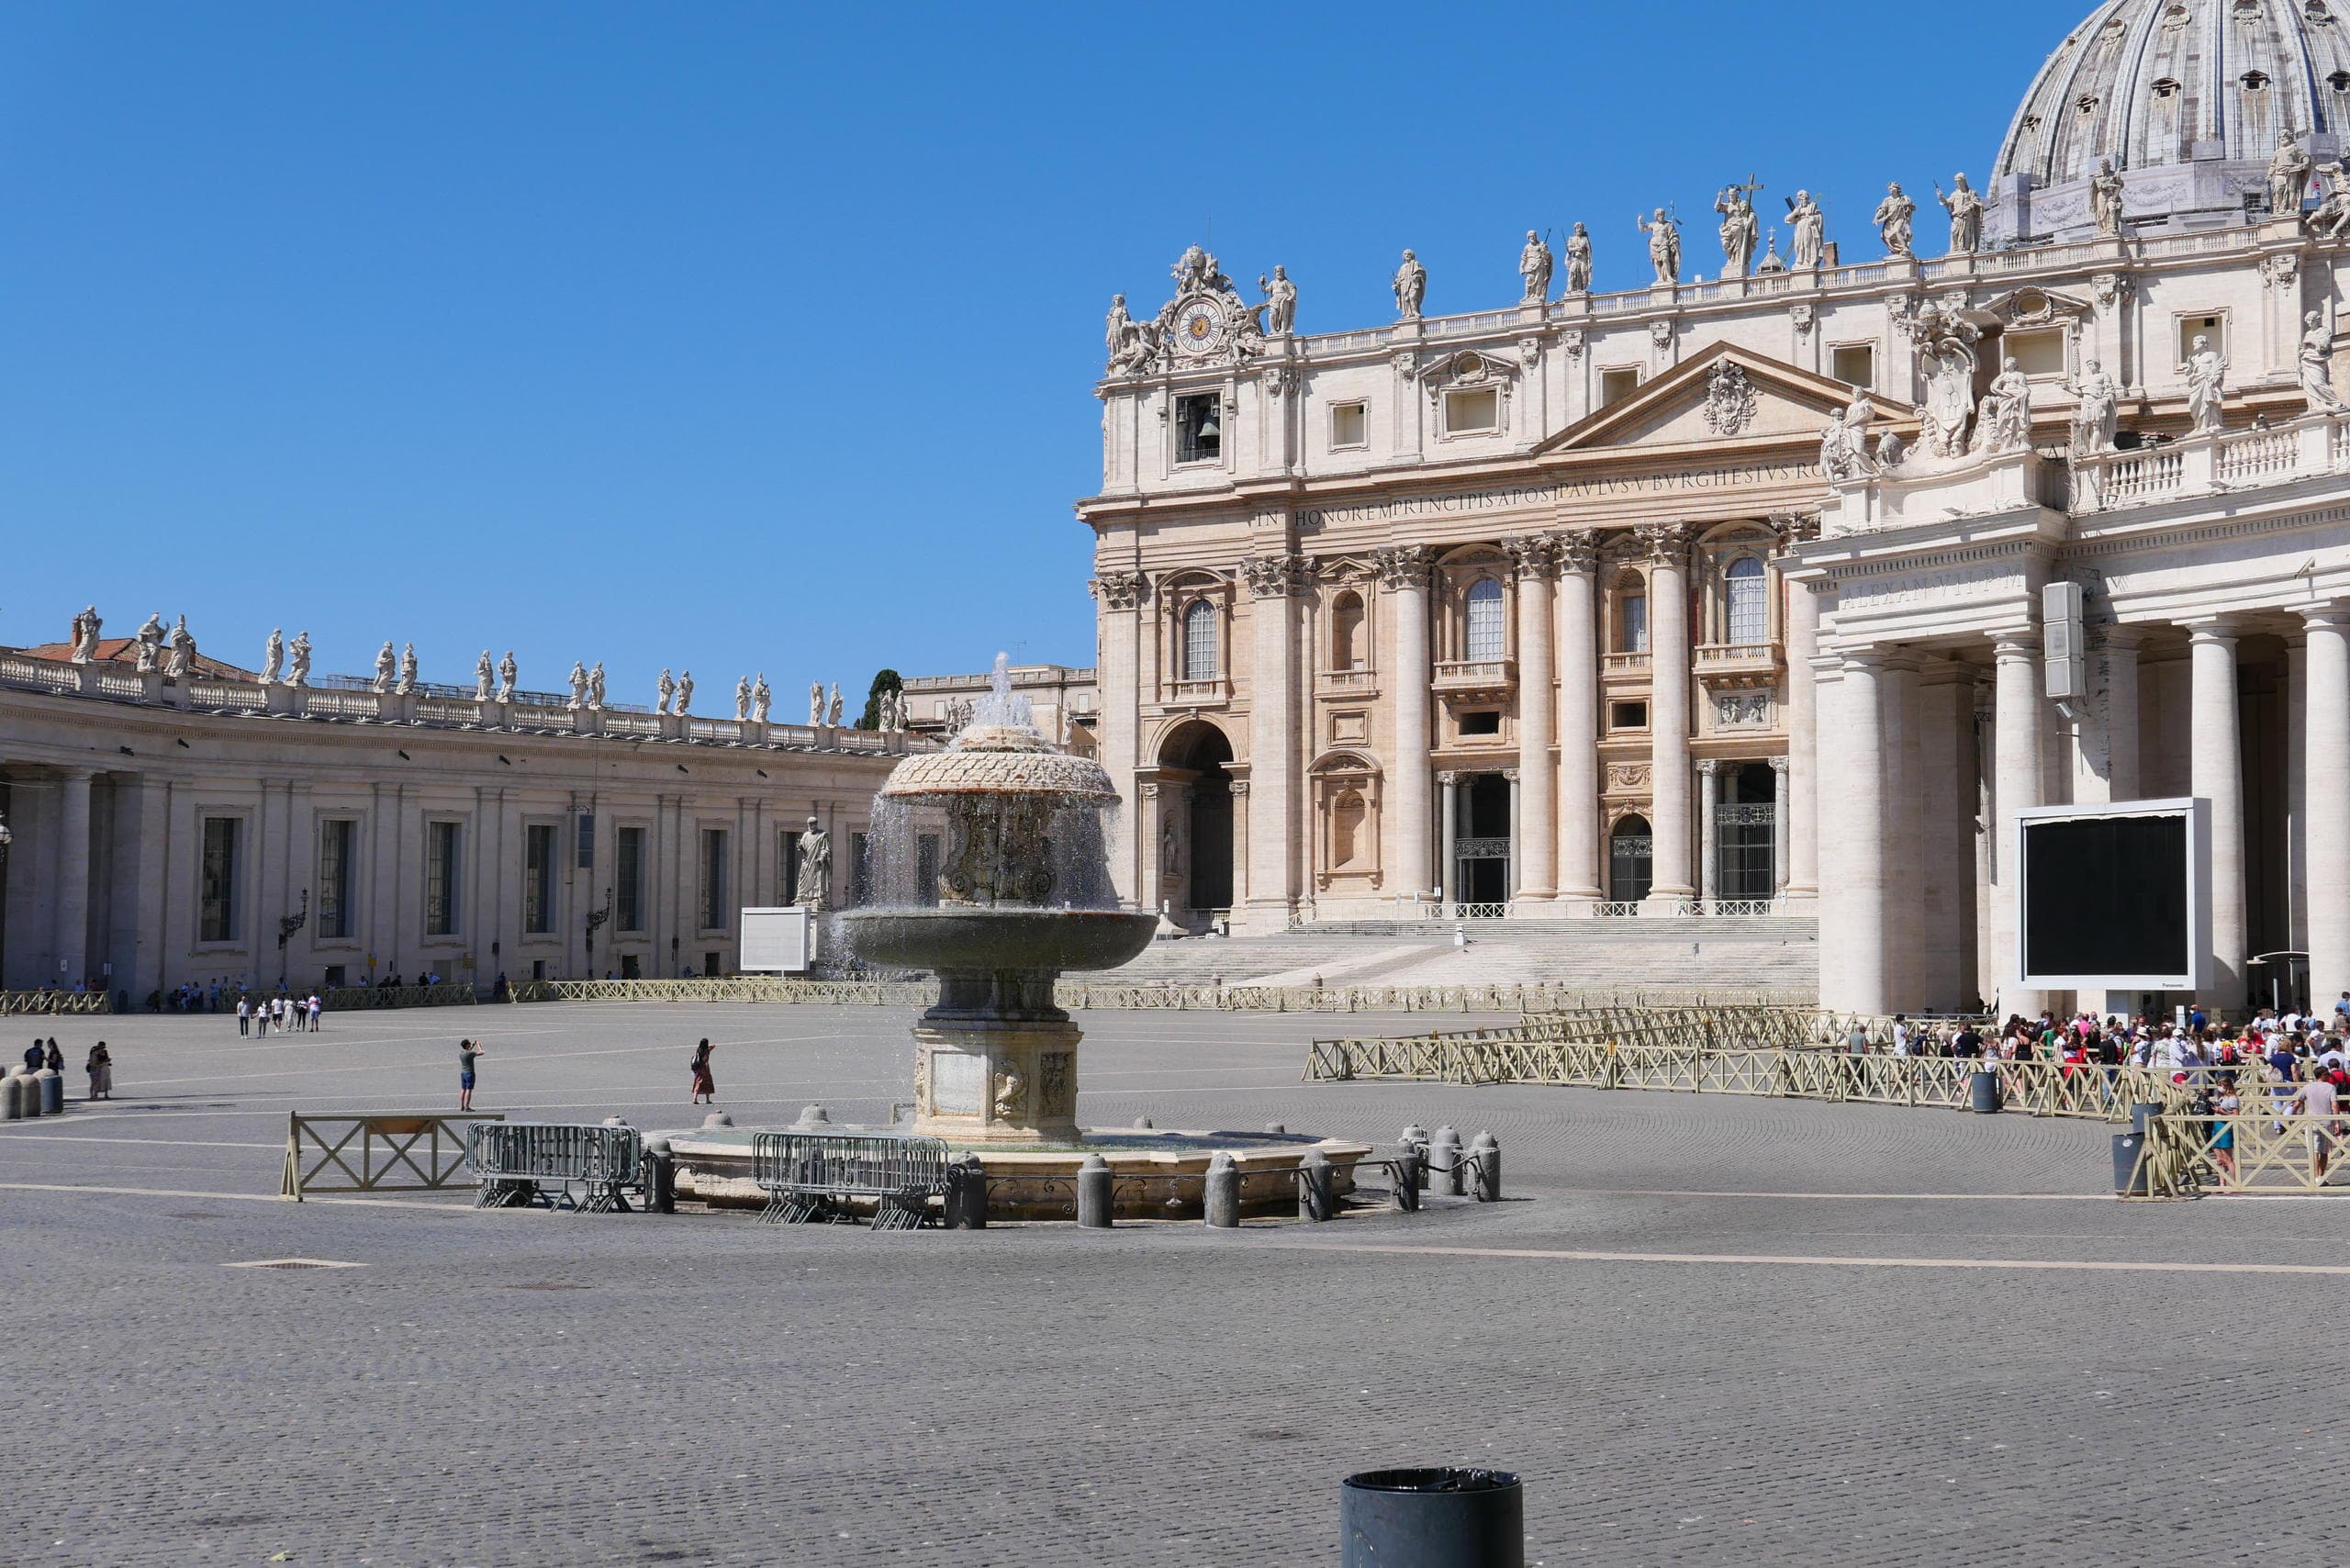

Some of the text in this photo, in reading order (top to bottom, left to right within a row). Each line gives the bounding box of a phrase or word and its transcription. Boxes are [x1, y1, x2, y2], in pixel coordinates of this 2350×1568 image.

[1258, 510, 1279, 527] IN
[1295, 504, 1392, 527] HONOREM
[1393, 491, 1493, 516] PRINCIPIS
[1560, 477, 1629, 498] PAVLVS
[1652, 464, 1788, 491] BVRGHESIVS
